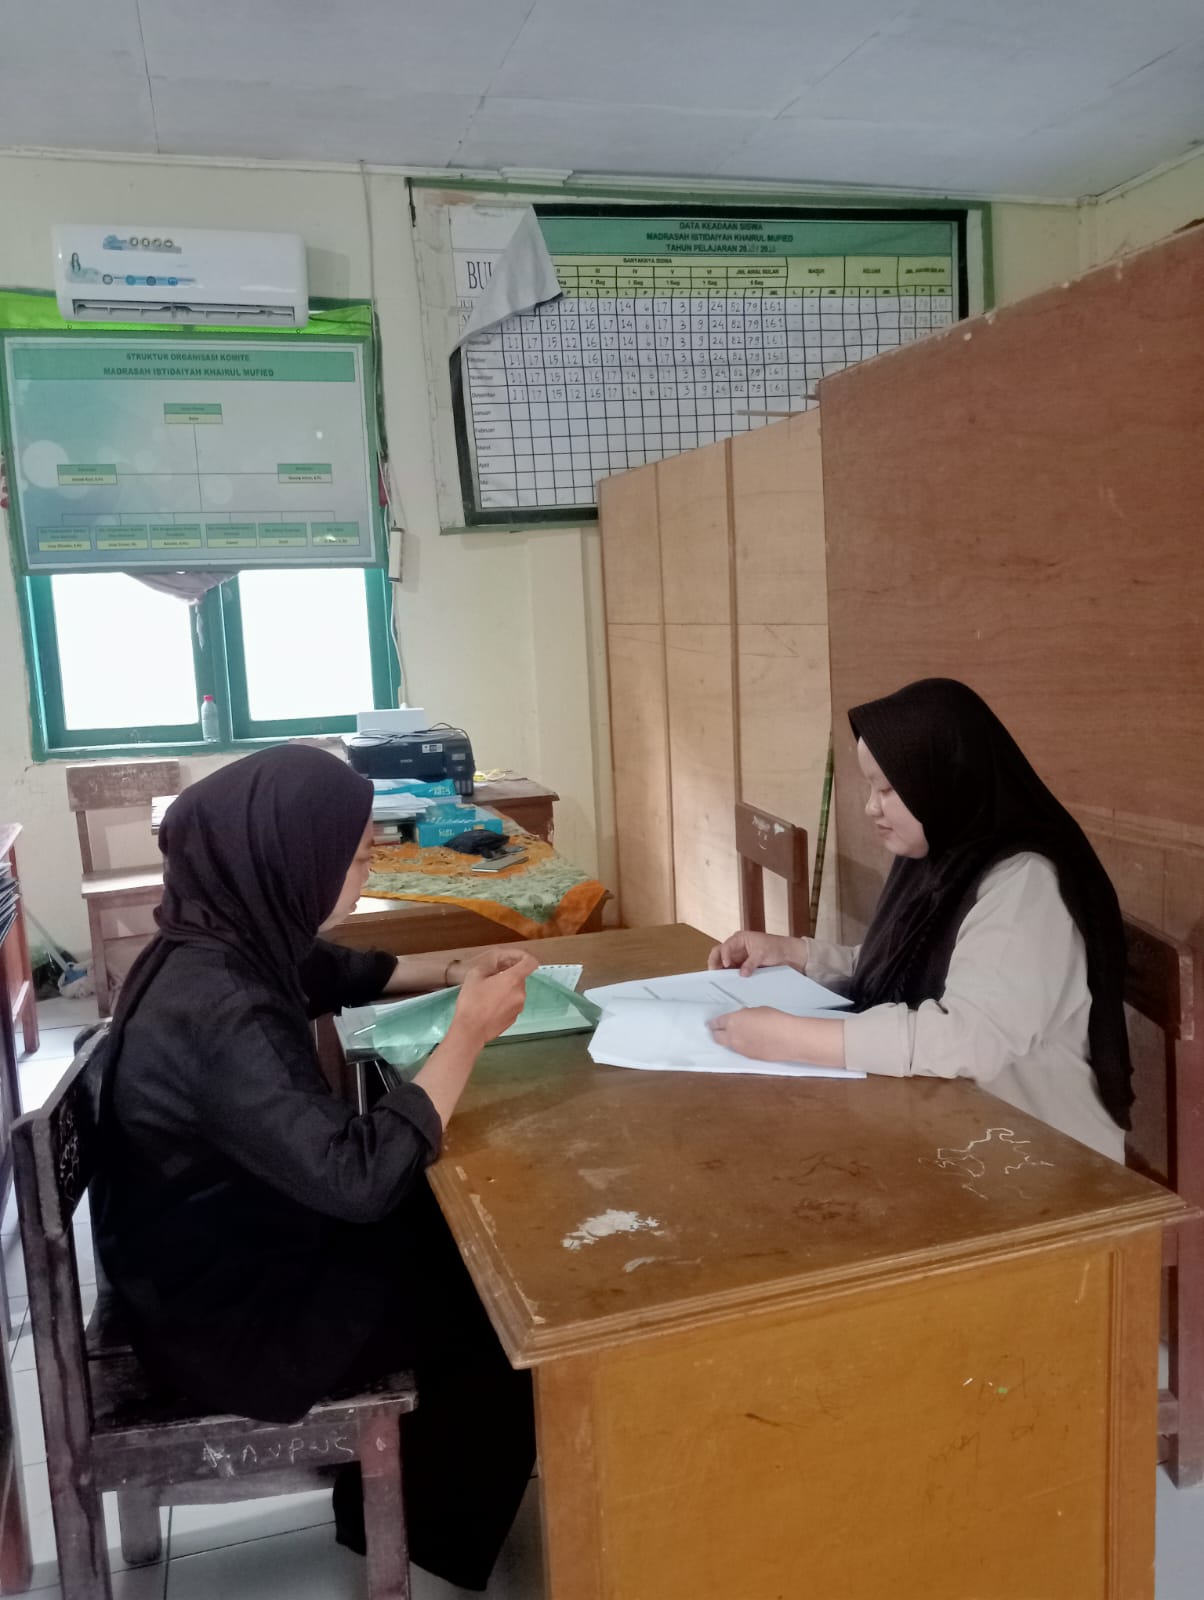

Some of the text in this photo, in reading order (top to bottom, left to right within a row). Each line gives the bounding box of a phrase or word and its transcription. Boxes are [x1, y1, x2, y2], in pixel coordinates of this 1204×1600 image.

[680, 222, 700, 230] DATA
[702, 222, 738, 231] KEADAAN
[647, 232, 689, 241] MADRASAH
[666, 244, 692, 252] TAHUN
[694, 244, 737, 253] PELAJARAN
[711, 302, 723, 312] 24
[546, 320, 557, 331] 15
[565, 320, 576, 331] 12
[712, 320, 724, 330] 24
[126, 352, 250, 362] STRUKTUR ORGANISASI KOMITE
[104, 367, 151, 376] MADRASAH
[204, 368, 241, 377] KHAIRUL
[244, 368, 274, 377] MUFIED
